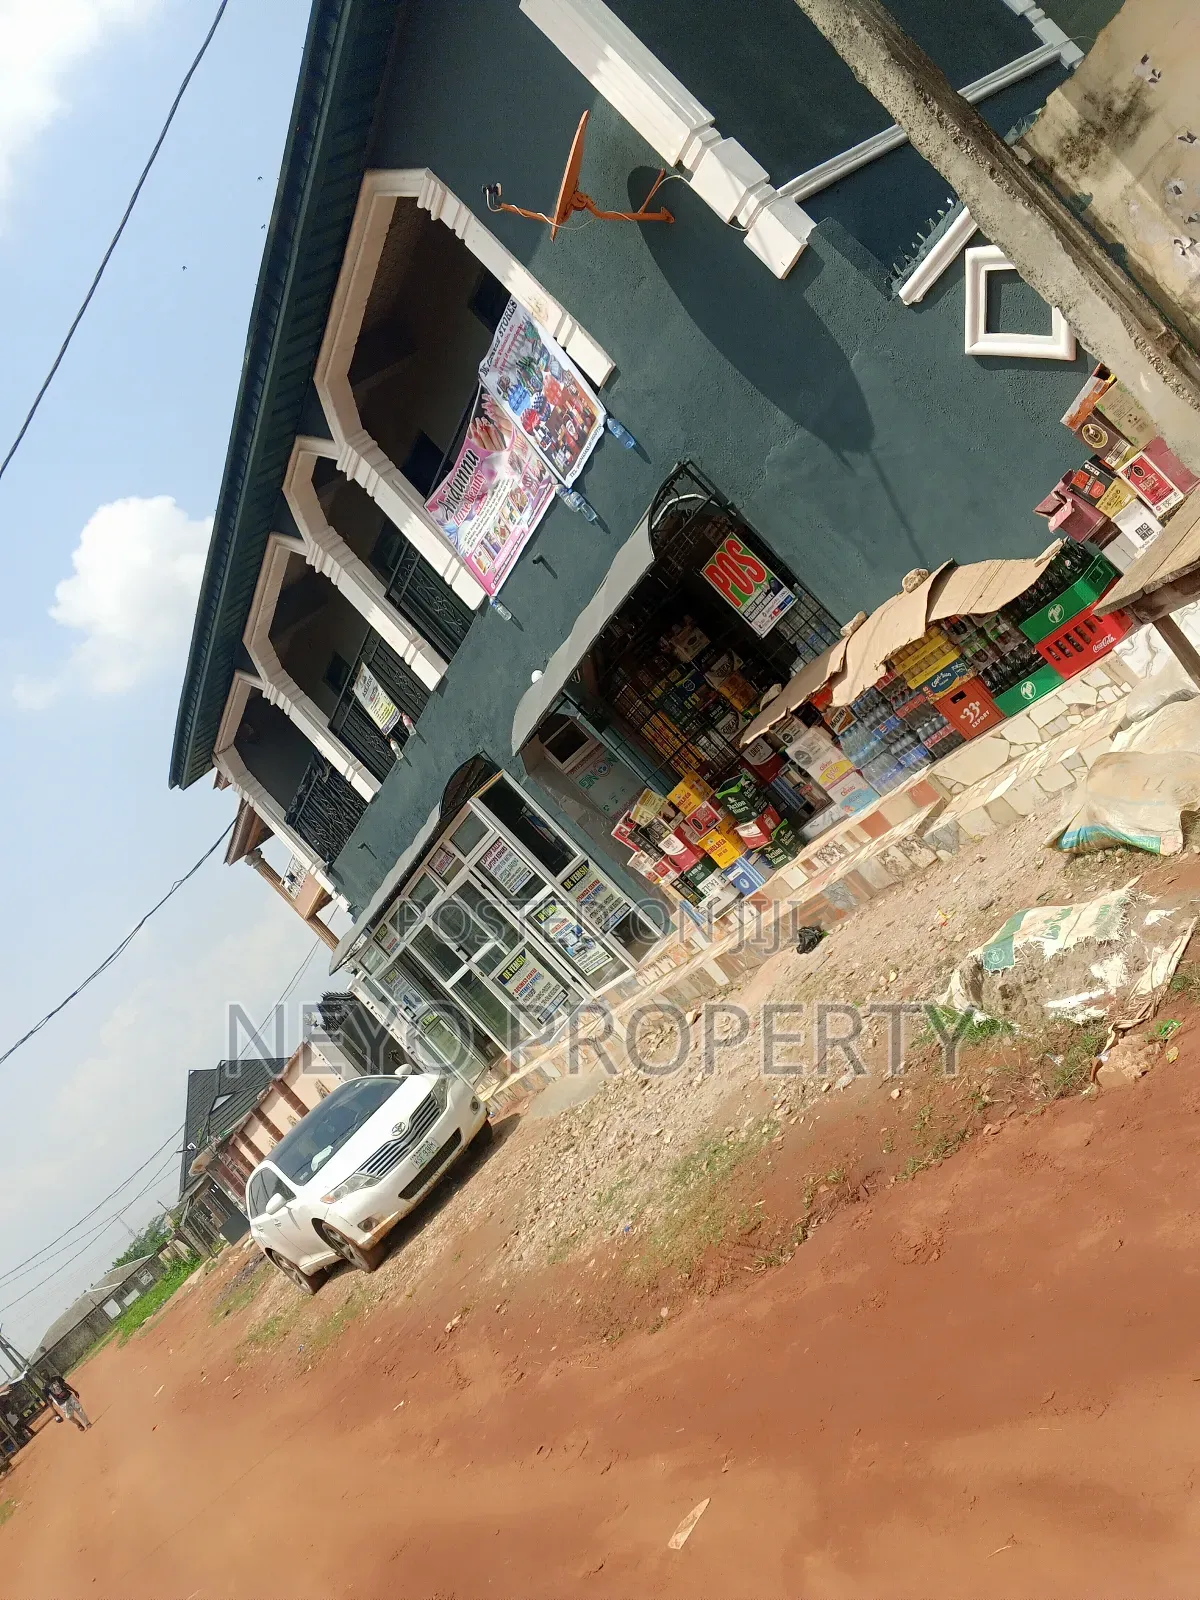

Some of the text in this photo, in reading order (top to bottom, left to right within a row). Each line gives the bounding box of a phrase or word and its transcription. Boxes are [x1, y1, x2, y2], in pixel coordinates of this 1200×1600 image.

[497, 299, 517, 336] STORES
[437, 448, 480, 521] Aridunnu
[1139, 472, 1159, 491] BEST
[452, 470, 486, 526] Luxe Beauty
[704, 537, 768, 608] POS
[828, 707, 847, 729] MALTINA
[971, 710, 990, 729] EXPORT
[726, 799, 746, 810] Action
[706, 836, 727, 856] CHELSEA
[765, 846, 783, 860] Action
[563, 863, 589, 889] DE YEMSIL
[502, 954, 526, 980] DE YEMSIL
[514, 977, 528, 993] BUSINESS
[517, 982, 532, 997] INTERNET
